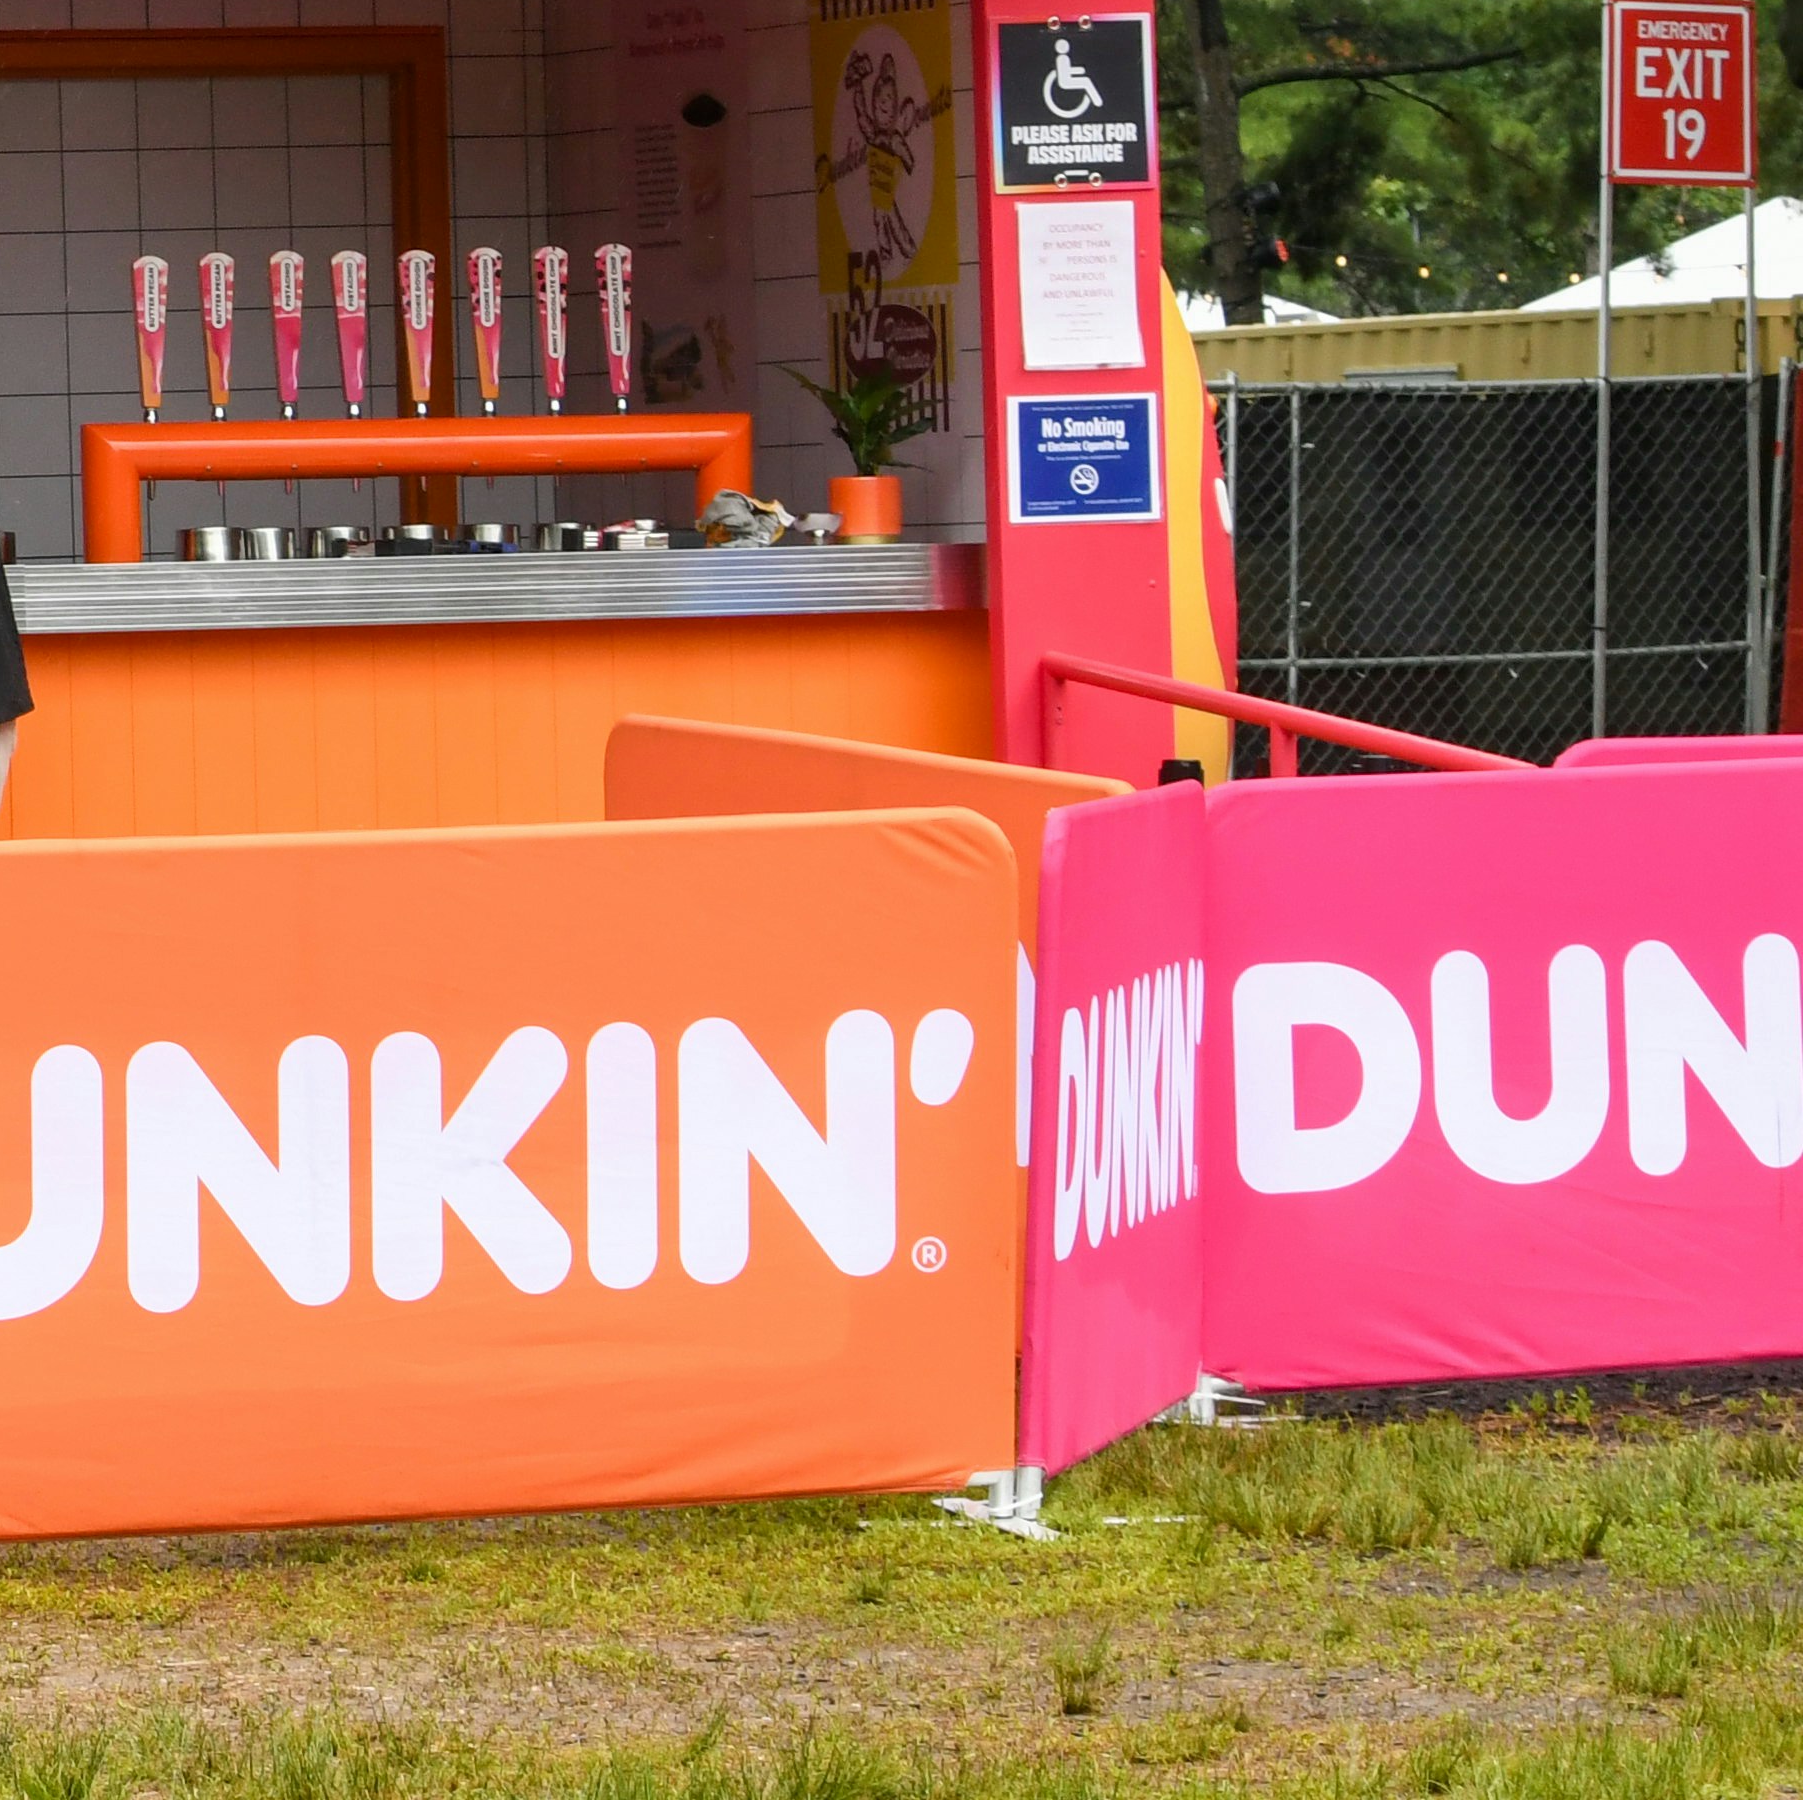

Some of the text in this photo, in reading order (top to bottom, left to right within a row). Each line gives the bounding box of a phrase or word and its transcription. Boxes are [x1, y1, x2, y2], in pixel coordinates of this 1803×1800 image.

[1637, 20, 1729, 41] EMERGENCY
[1636, 46, 1731, 100] EXIT
[1011, 122, 1138, 145] PLEASE ASK FOR
[1662, 108, 1706, 160] 19
[1027, 143, 1124, 165] ASSISTANCE
[1086, 239, 1111, 248] THAN
[147, 267, 156, 328] BUTTER PECAN
[215, 293, 223, 325] BUTTER
[549, 286, 557, 331] CHOCOLATE
[611, 283, 620, 330] CHOCOLATE
[1041, 416, 1125, 439] No Smoking
[1232, 932, 1803, 1196] DUN
